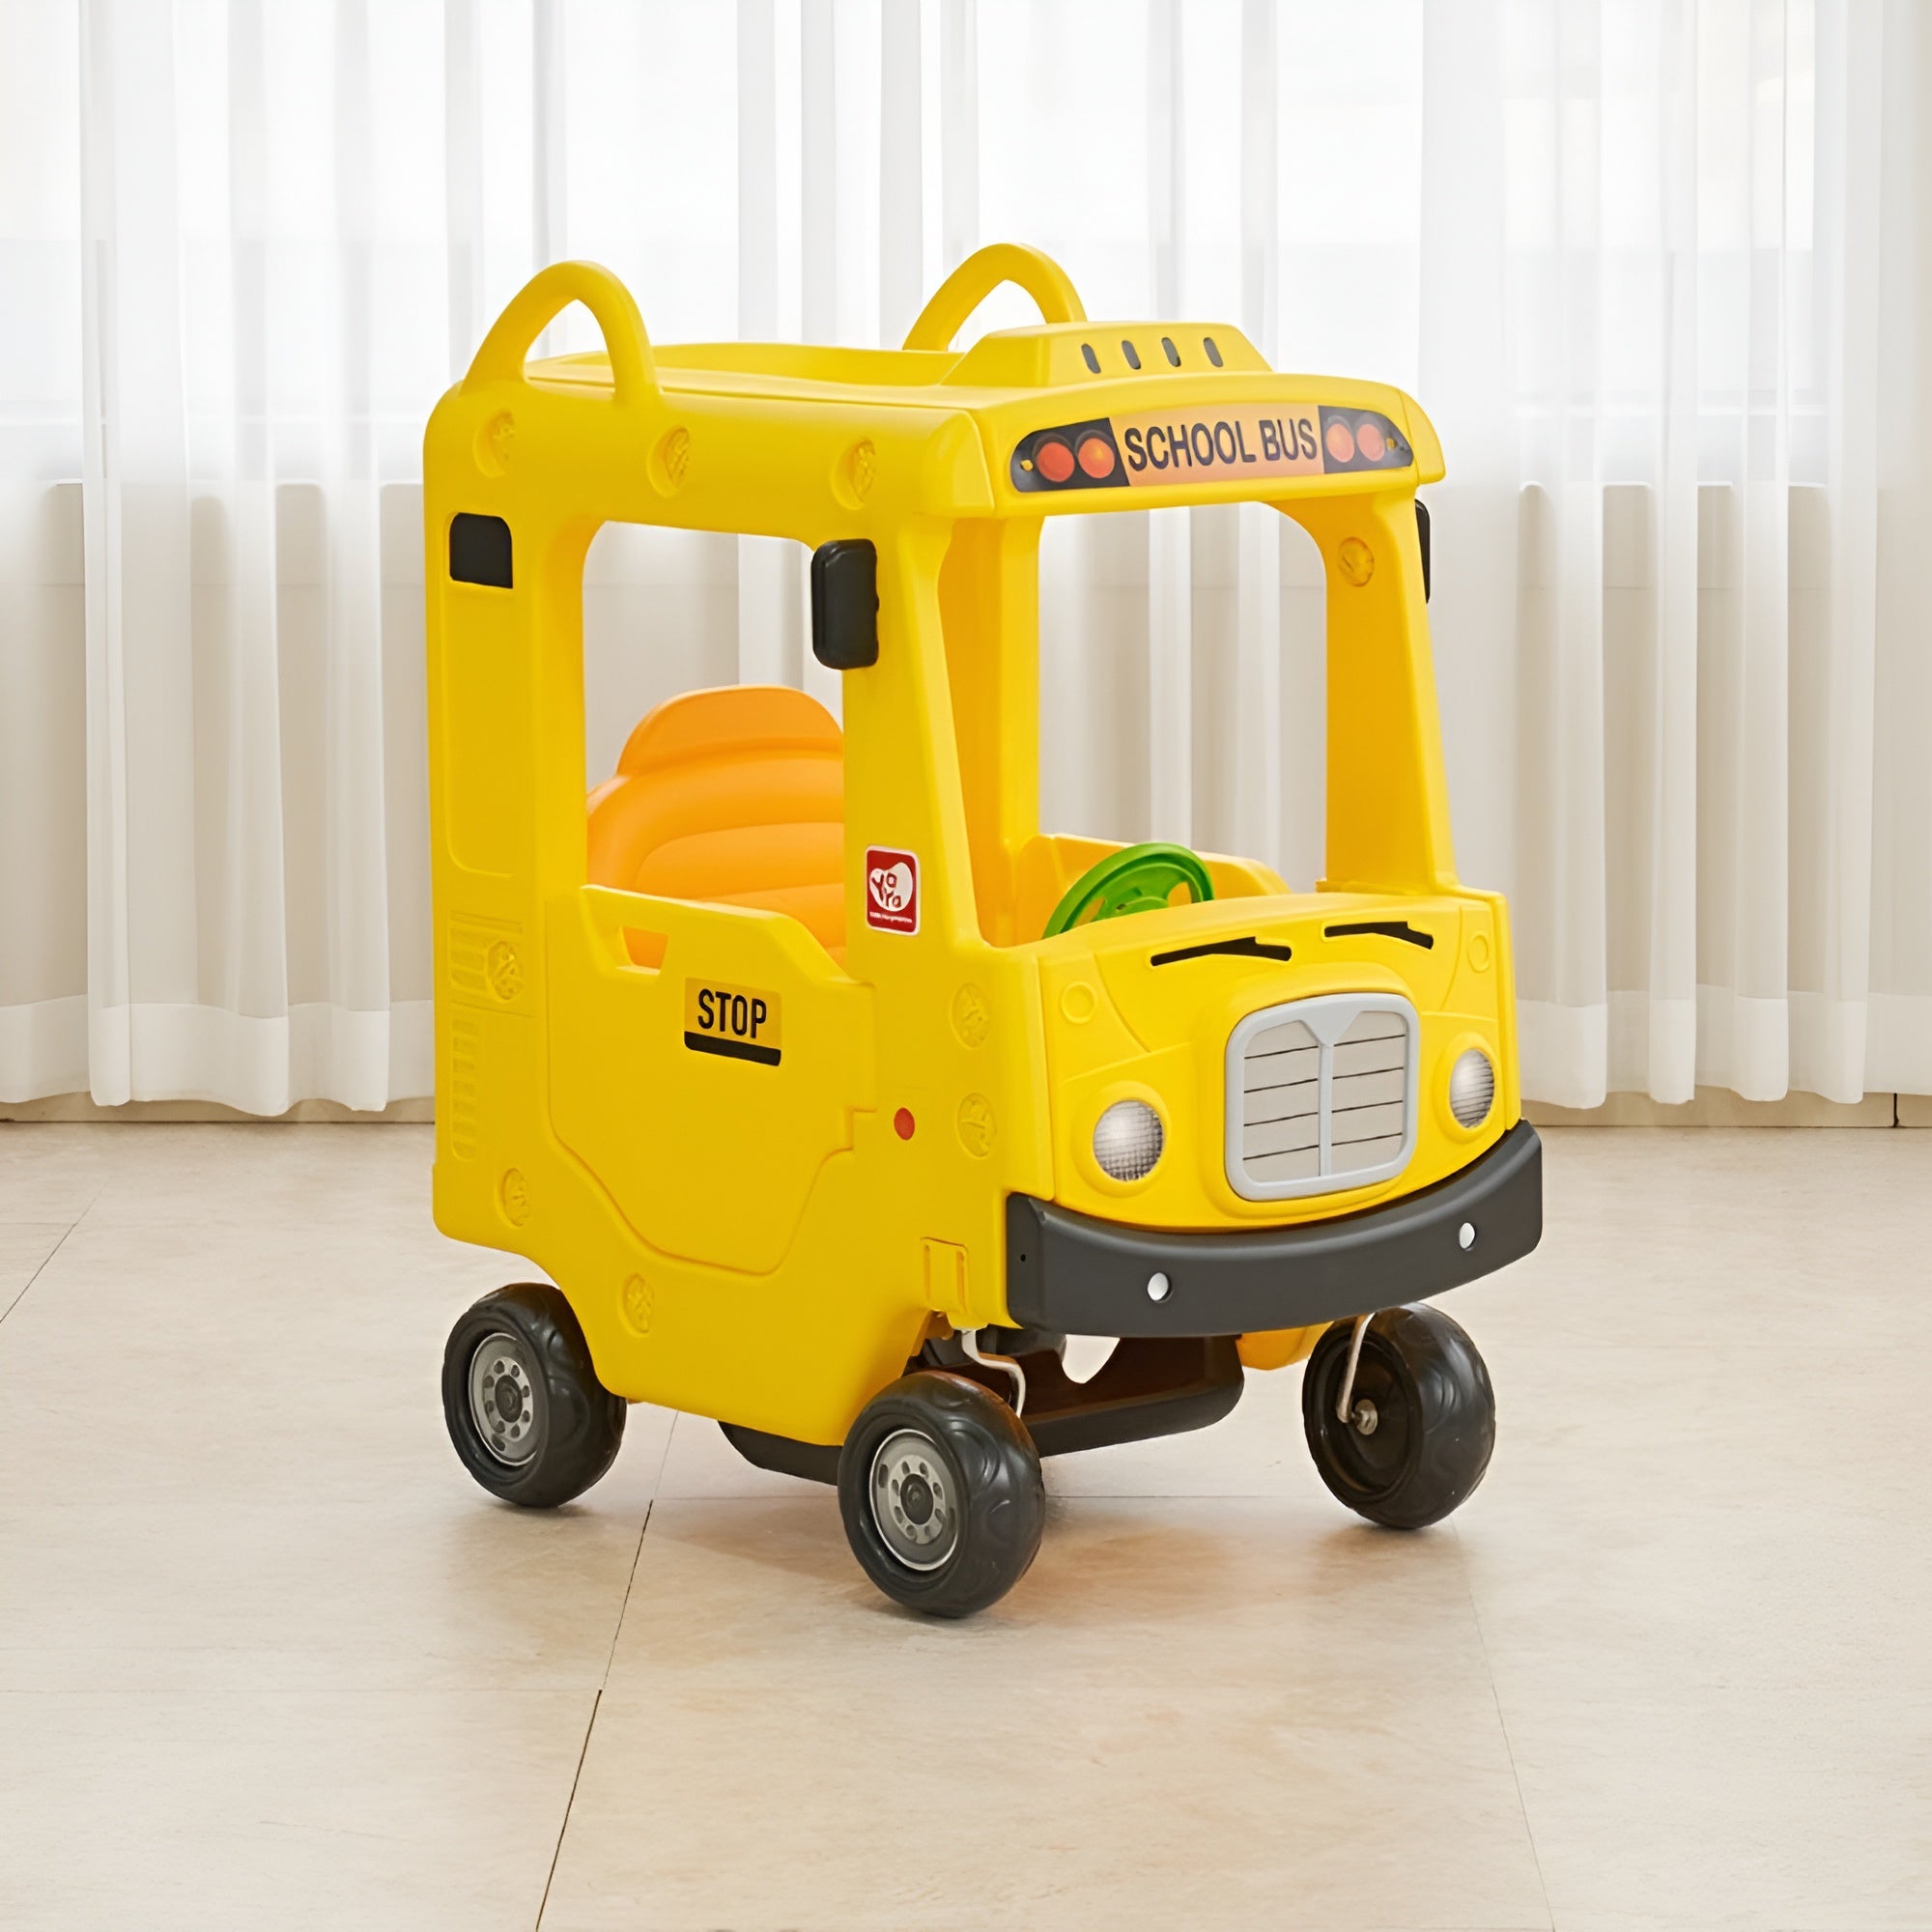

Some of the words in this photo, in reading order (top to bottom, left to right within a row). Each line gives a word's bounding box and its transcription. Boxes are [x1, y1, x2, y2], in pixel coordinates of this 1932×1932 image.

[1124, 420, 1257, 472] SCHOOL
[1260, 417, 1318, 462] BUS
[697, 988, 767, 1039] STOP
